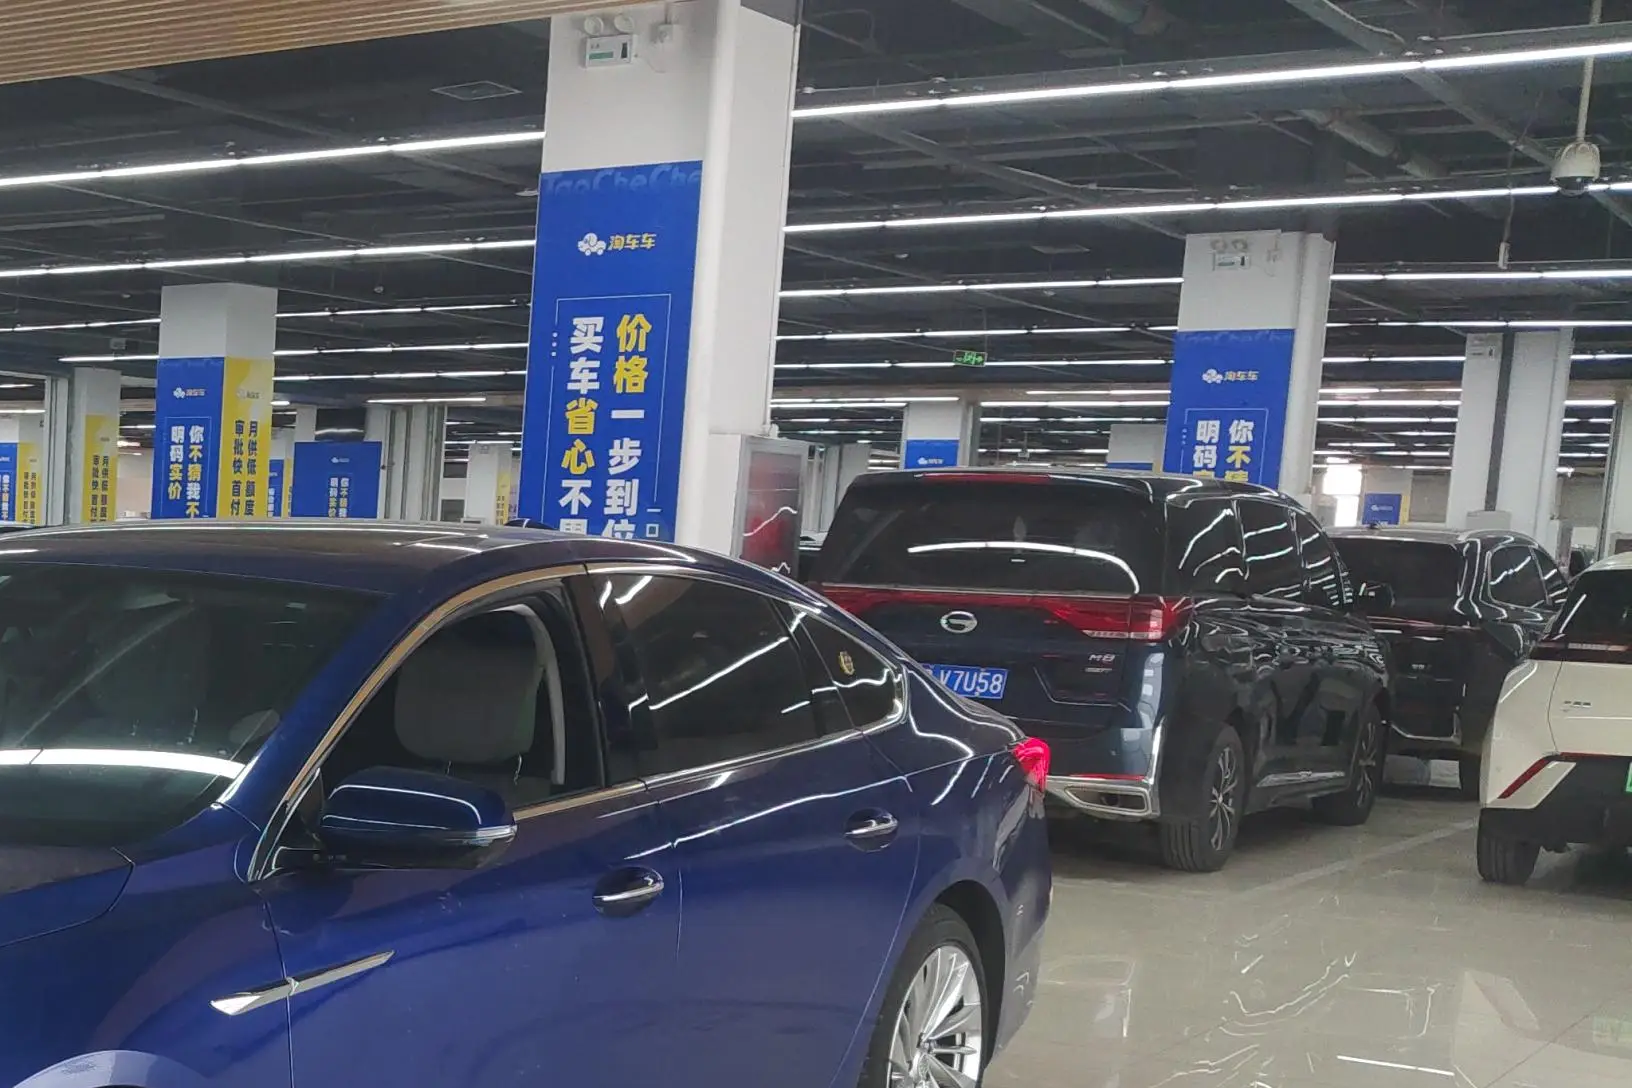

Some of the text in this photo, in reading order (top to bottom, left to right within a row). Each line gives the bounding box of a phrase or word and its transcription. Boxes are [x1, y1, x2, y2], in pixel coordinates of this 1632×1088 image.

[608, 233, 657, 251] 淘车车
[168, 425, 186, 500] 明码实价
[925, 669, 1003, 694] V7U58
